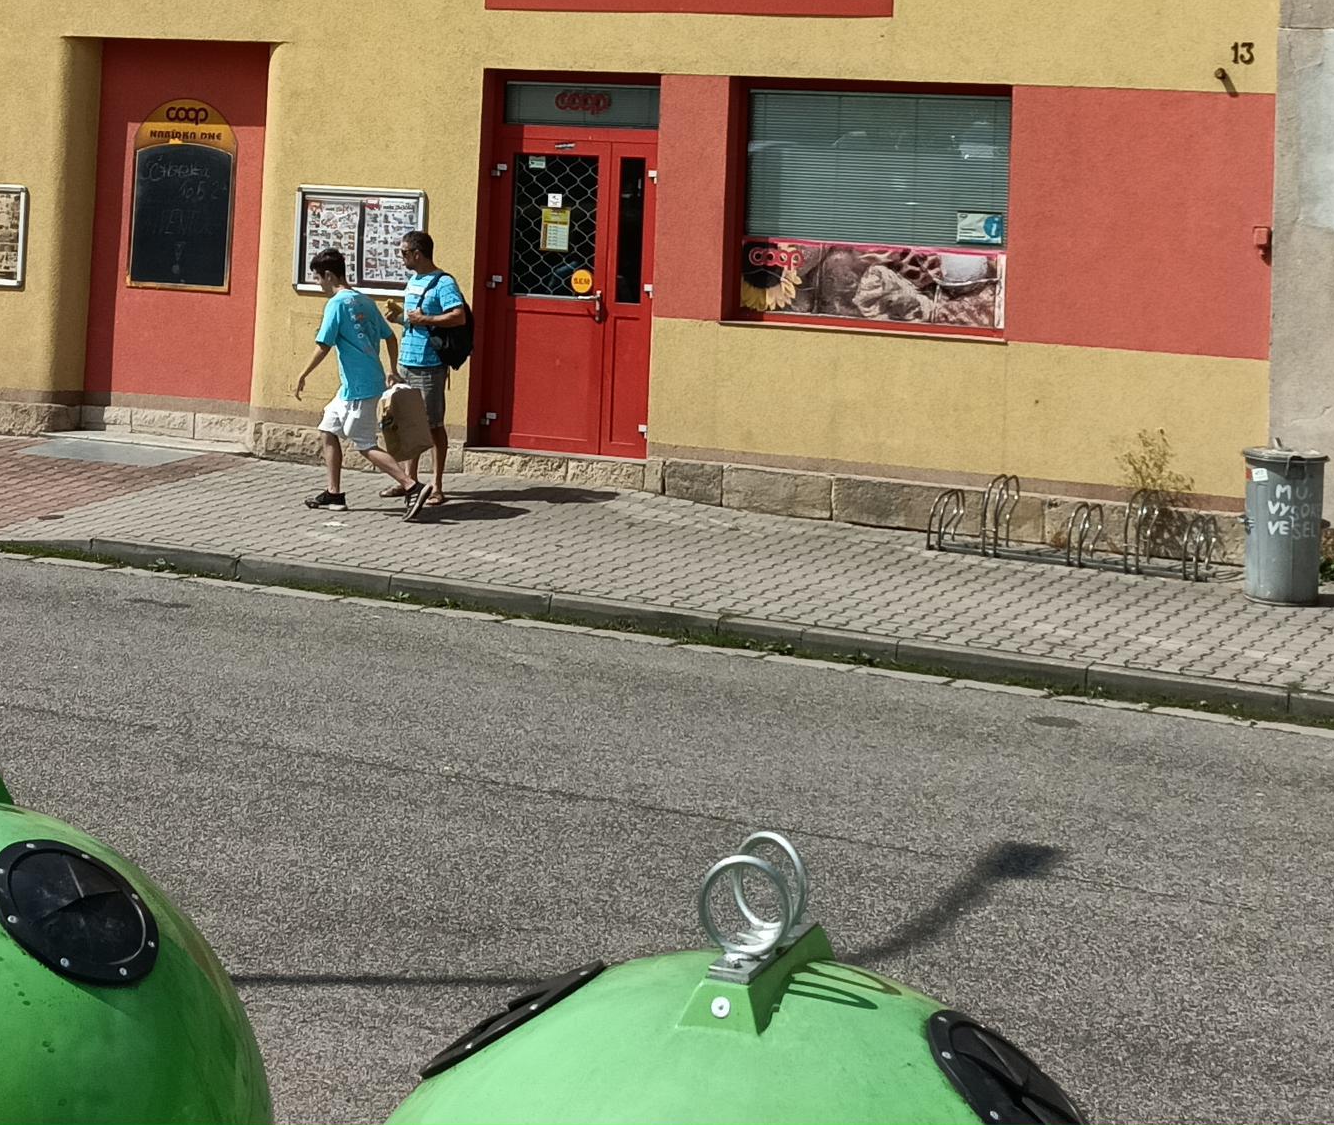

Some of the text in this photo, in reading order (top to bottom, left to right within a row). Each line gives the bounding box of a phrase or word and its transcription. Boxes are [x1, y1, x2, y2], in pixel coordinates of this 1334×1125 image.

[1230, 41, 1255, 65] 13
[554, 91, 612, 115] coop
[166, 106, 209, 125] coop
[200, 131, 223, 141] DNE
[749, 247, 805, 271] coop
